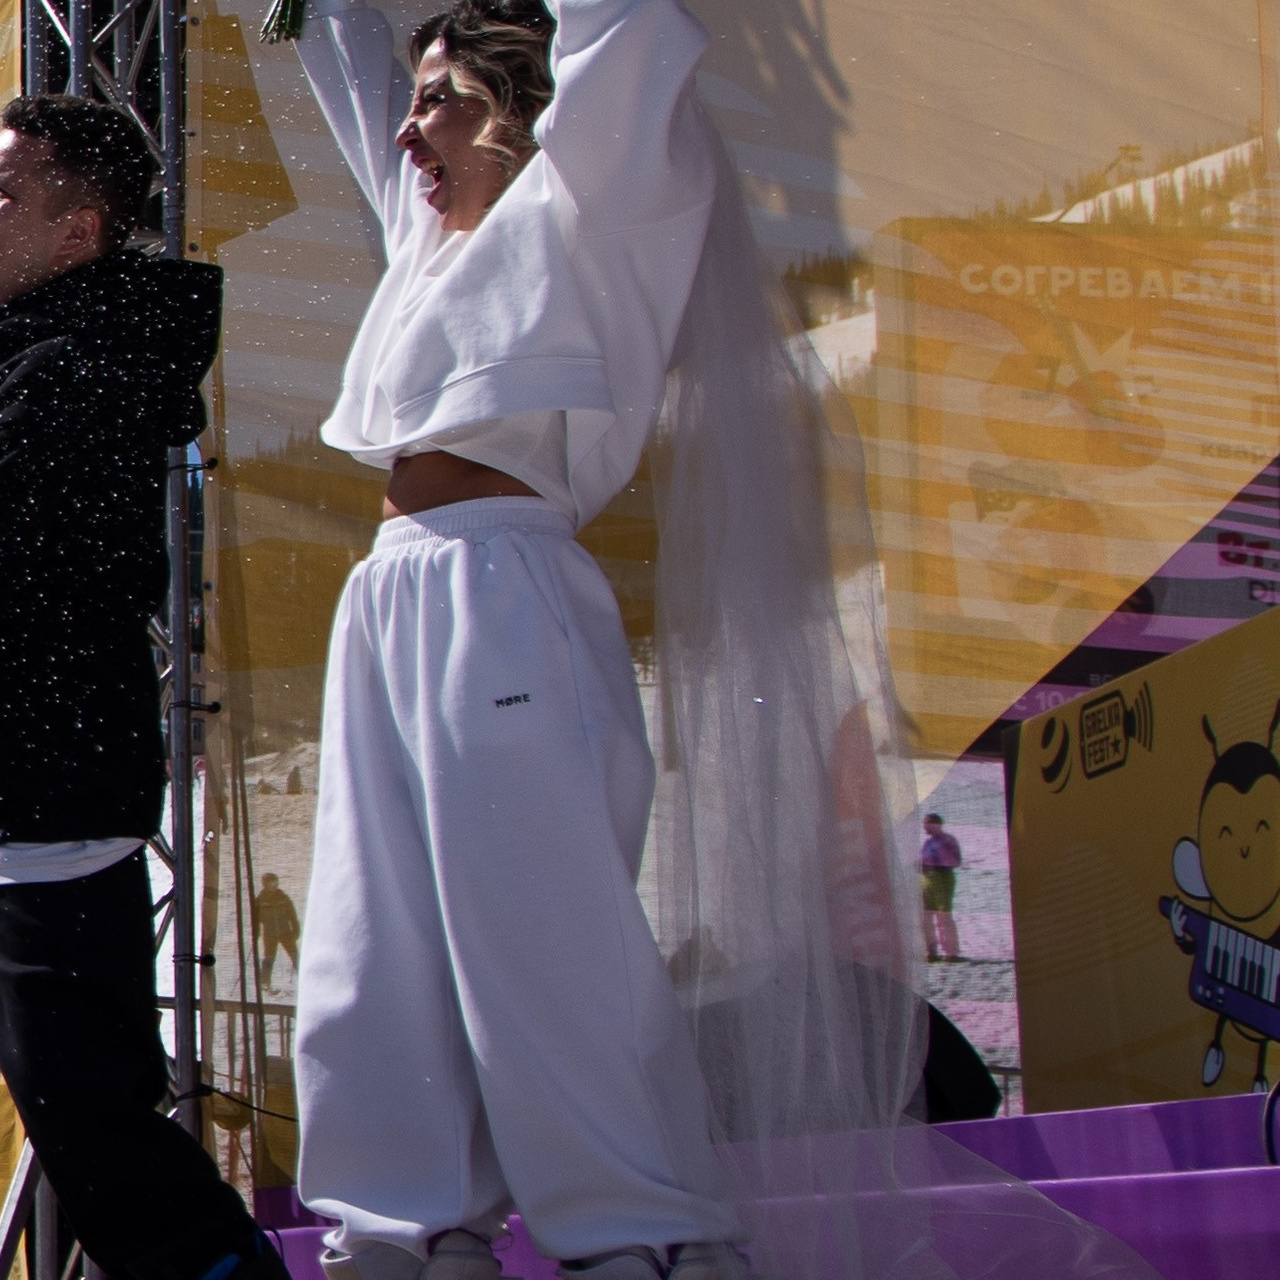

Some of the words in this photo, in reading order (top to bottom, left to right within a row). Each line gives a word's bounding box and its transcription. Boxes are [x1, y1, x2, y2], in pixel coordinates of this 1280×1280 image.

[959, 264, 1243, 303] СОГРЕВАЕМ
[1085, 702, 1121, 739] GRELKA
[1087, 734, 1113, 767] FEST
